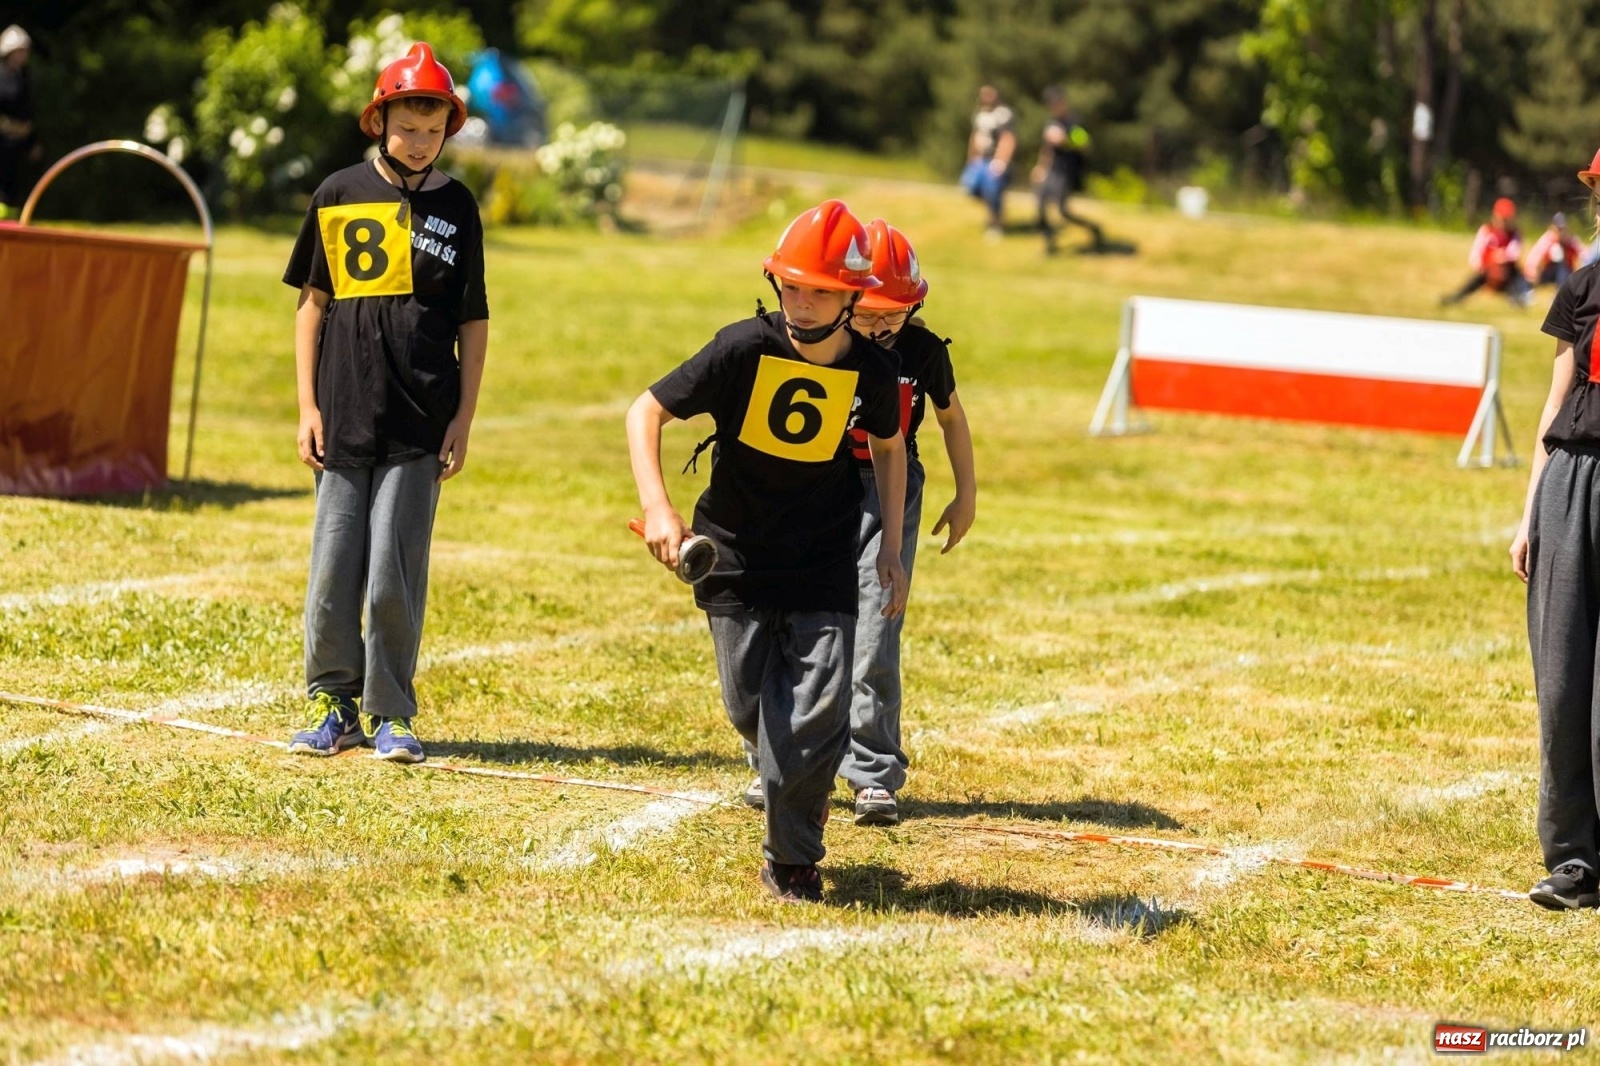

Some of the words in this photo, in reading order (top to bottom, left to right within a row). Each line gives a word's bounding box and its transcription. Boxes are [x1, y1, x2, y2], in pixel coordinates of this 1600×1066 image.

[343, 218, 389, 282] 8
[424, 215, 457, 238] MDP
[767, 377, 828, 445] 6
